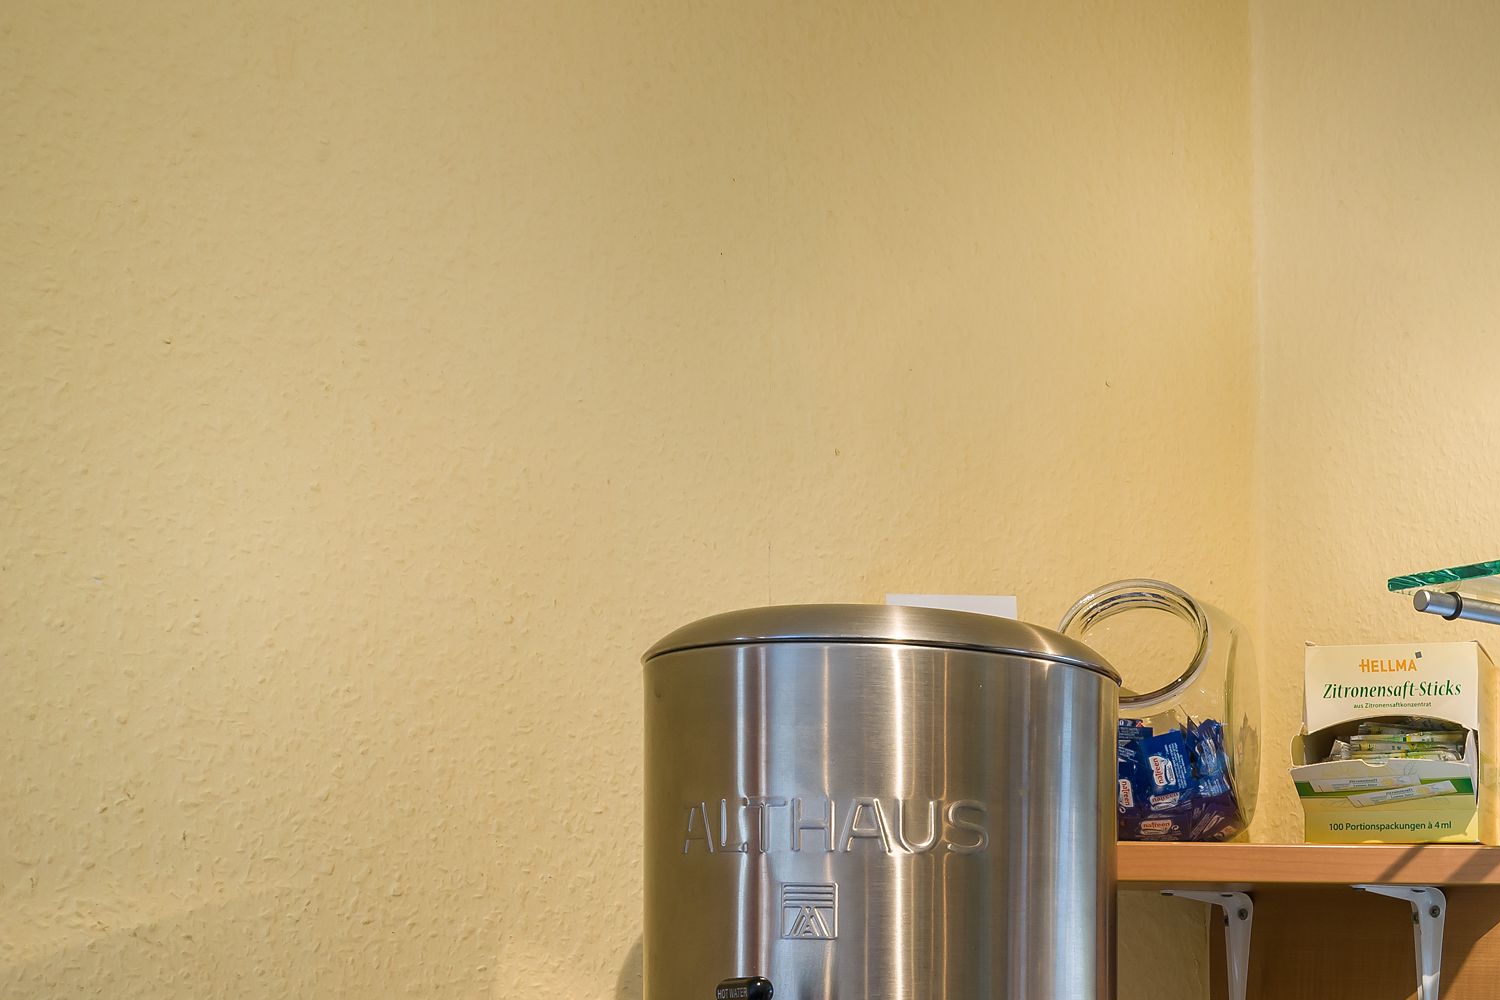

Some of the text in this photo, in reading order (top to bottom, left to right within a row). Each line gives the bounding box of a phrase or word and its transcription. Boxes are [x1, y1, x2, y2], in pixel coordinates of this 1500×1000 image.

[1359, 658, 1418, 673] HELLMA
[1322, 679, 1462, 700] Zitronensaft-Sticks
[1365, 701, 1432, 709] Zitronensaftkonzentrat
[682, 797, 990, 857] ALTHAUS
[1329, 823, 1344, 831] 100
[1345, 821, 1426, 833] Portionspackungen
[1428, 820, 1433, 830] à
[717, 986, 748, 999] HOT WATER
